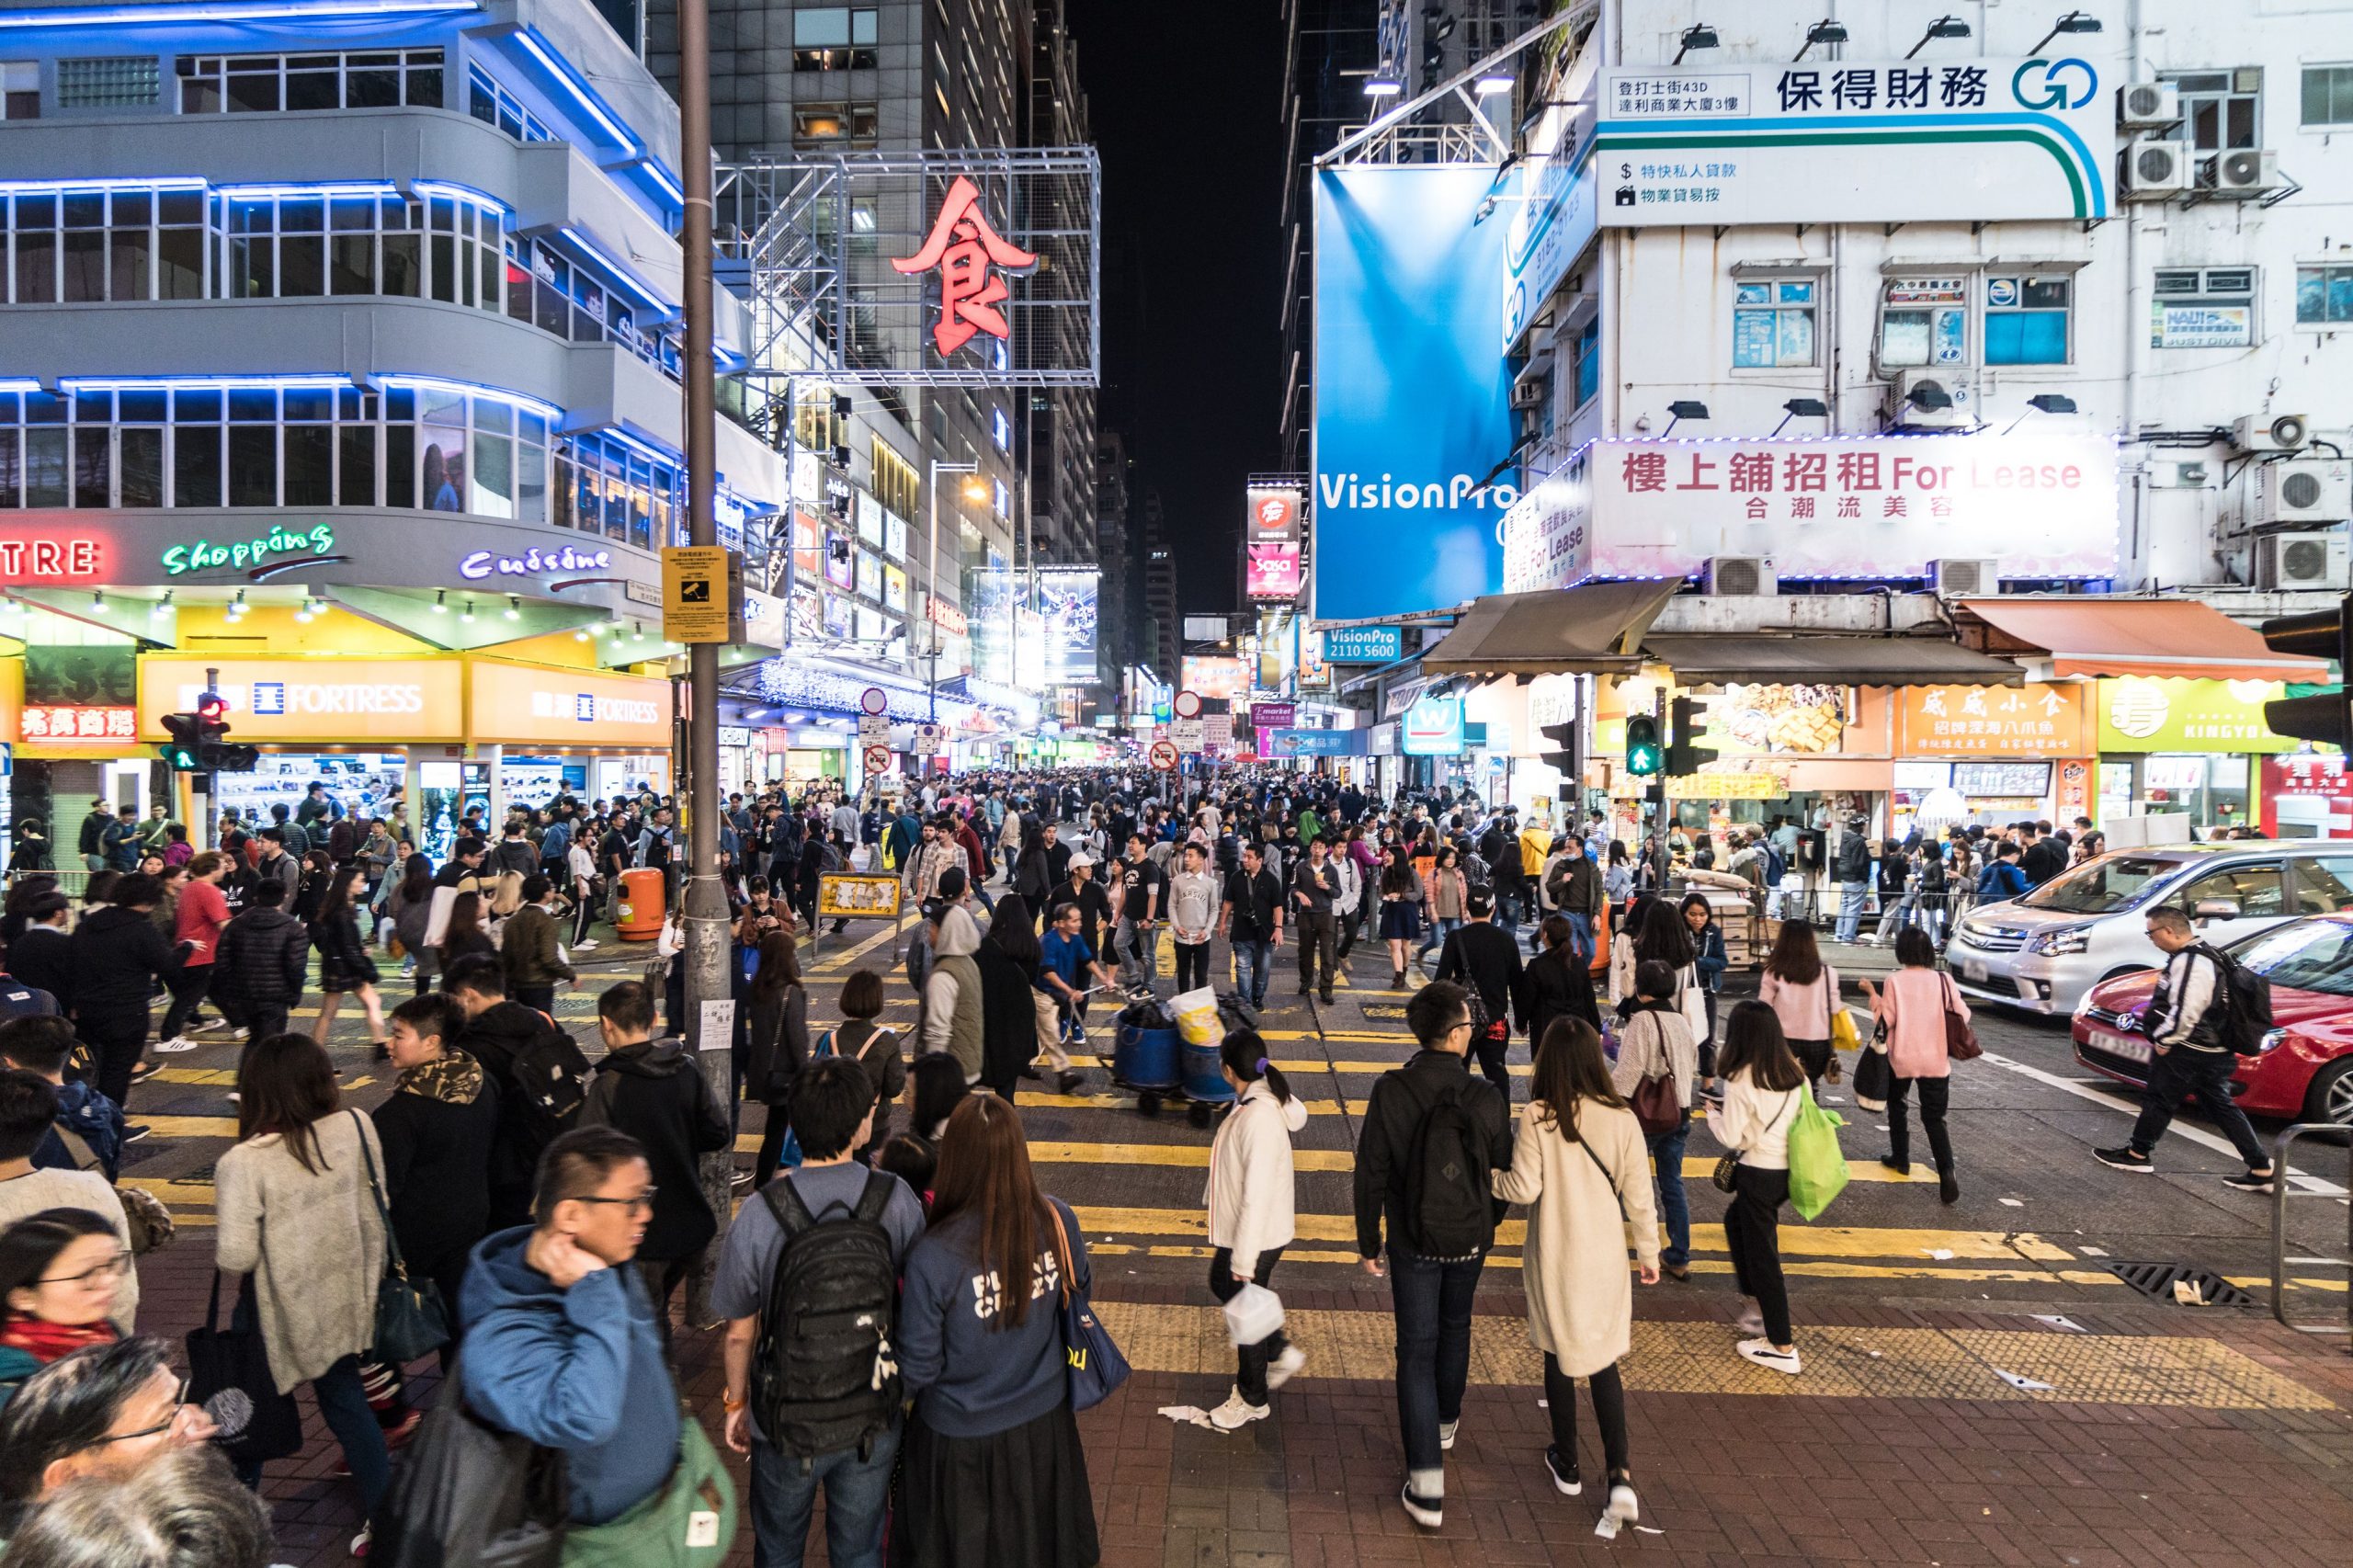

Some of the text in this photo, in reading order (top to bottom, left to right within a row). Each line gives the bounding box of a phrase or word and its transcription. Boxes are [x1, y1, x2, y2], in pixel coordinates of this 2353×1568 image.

[1618, 80, 1708, 96] 登打士街43D
[1777, 65, 1988, 111] 保得財務
[1640, 163, 1736, 179] 特快私人貸款
[891, 175, 1037, 357] 食
[2207, 336, 2244, 346] DIVE
[1621, 451, 2082, 494] 樓上舖招租 For Lease
[1319, 473, 1518, 509] VisionPro
[1745, 496, 1954, 519] 合潮流美容
[162, 524, 335, 575] Shopping
[1550, 525, 1583, 561] Lease
[460, 546, 610, 580] Cuisine
[1330, 629, 1395, 643] VisionPro
[1330, 645, 1394, 657] 2110 5600
[289, 684, 423, 714] FORTRESS
[596, 697, 659, 724] FORTRESS
[1934, 721, 2055, 736] 招牌深海八爪魚
[2184, 724, 2258, 739] KINGYO
